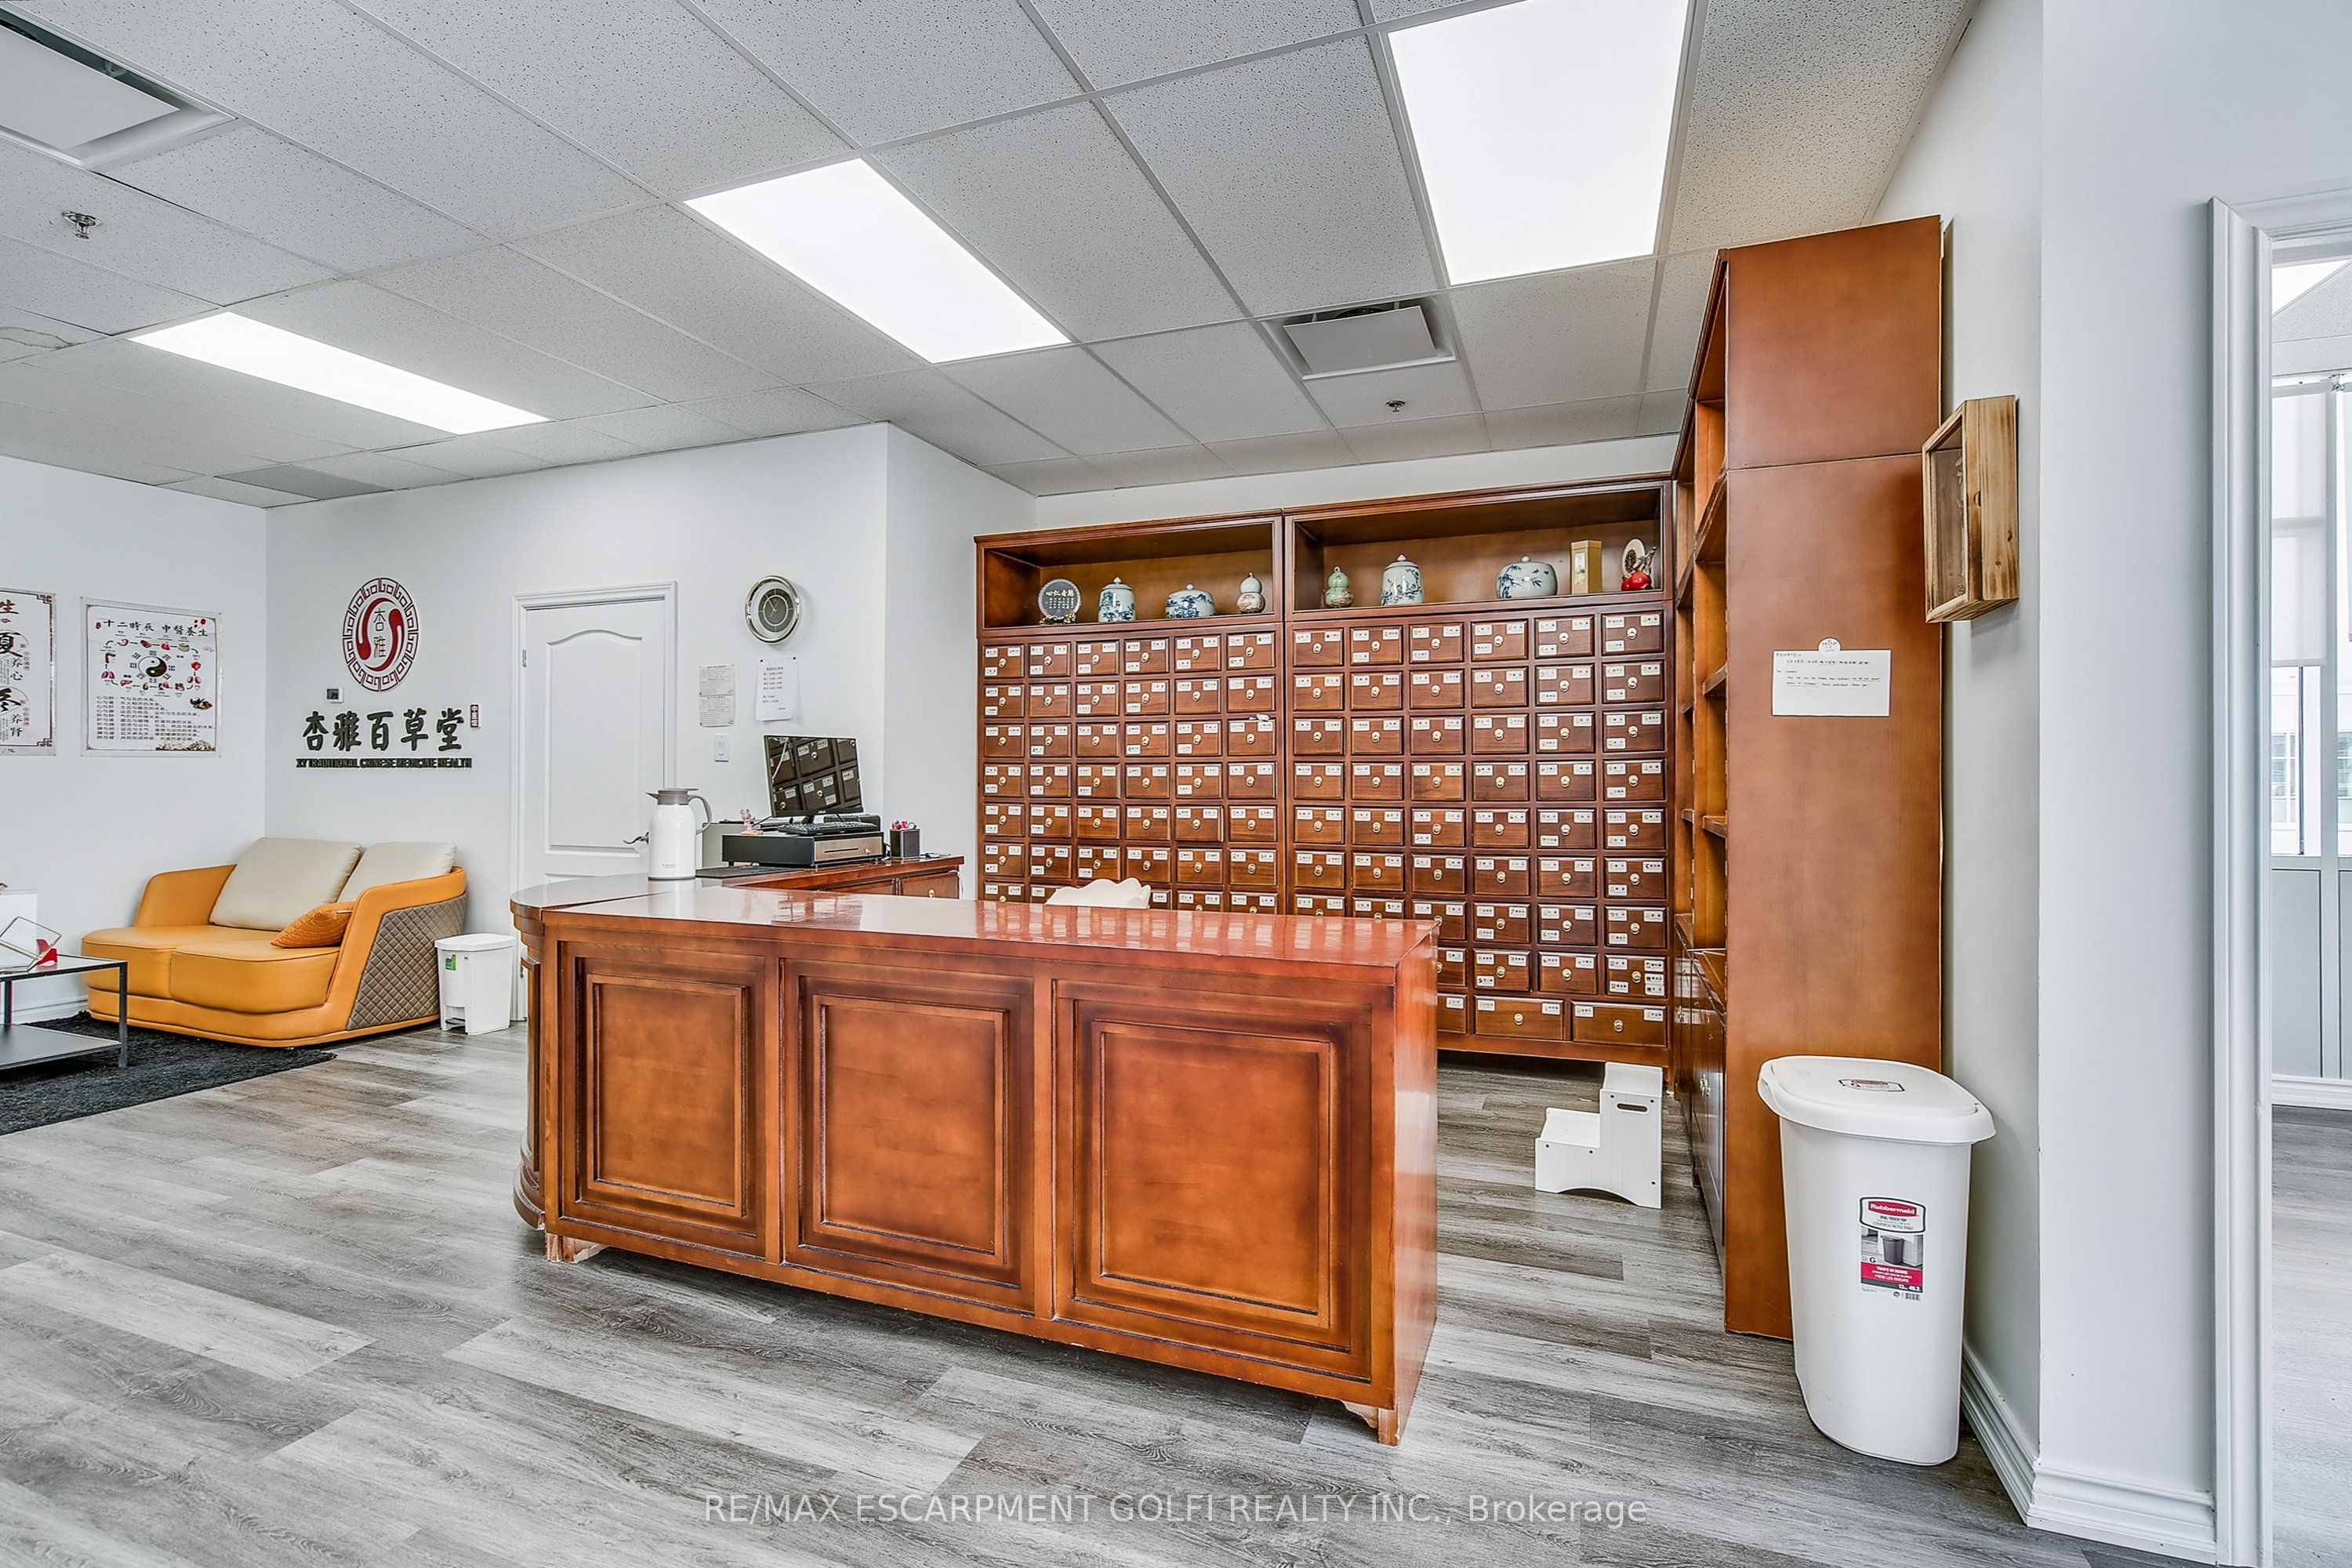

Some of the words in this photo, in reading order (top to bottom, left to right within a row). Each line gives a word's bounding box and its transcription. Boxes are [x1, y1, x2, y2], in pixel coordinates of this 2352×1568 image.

[303, 707, 465, 752] 杏雅百草堂
[307, 758, 359, 768] TRADITIONAL
[360, 758, 396, 768] CHINESE
[396, 758, 437, 768] MEDICINE
[437, 758, 472, 768] HEALTH
[1870, 1203, 1915, 1214] Rubbermaid
